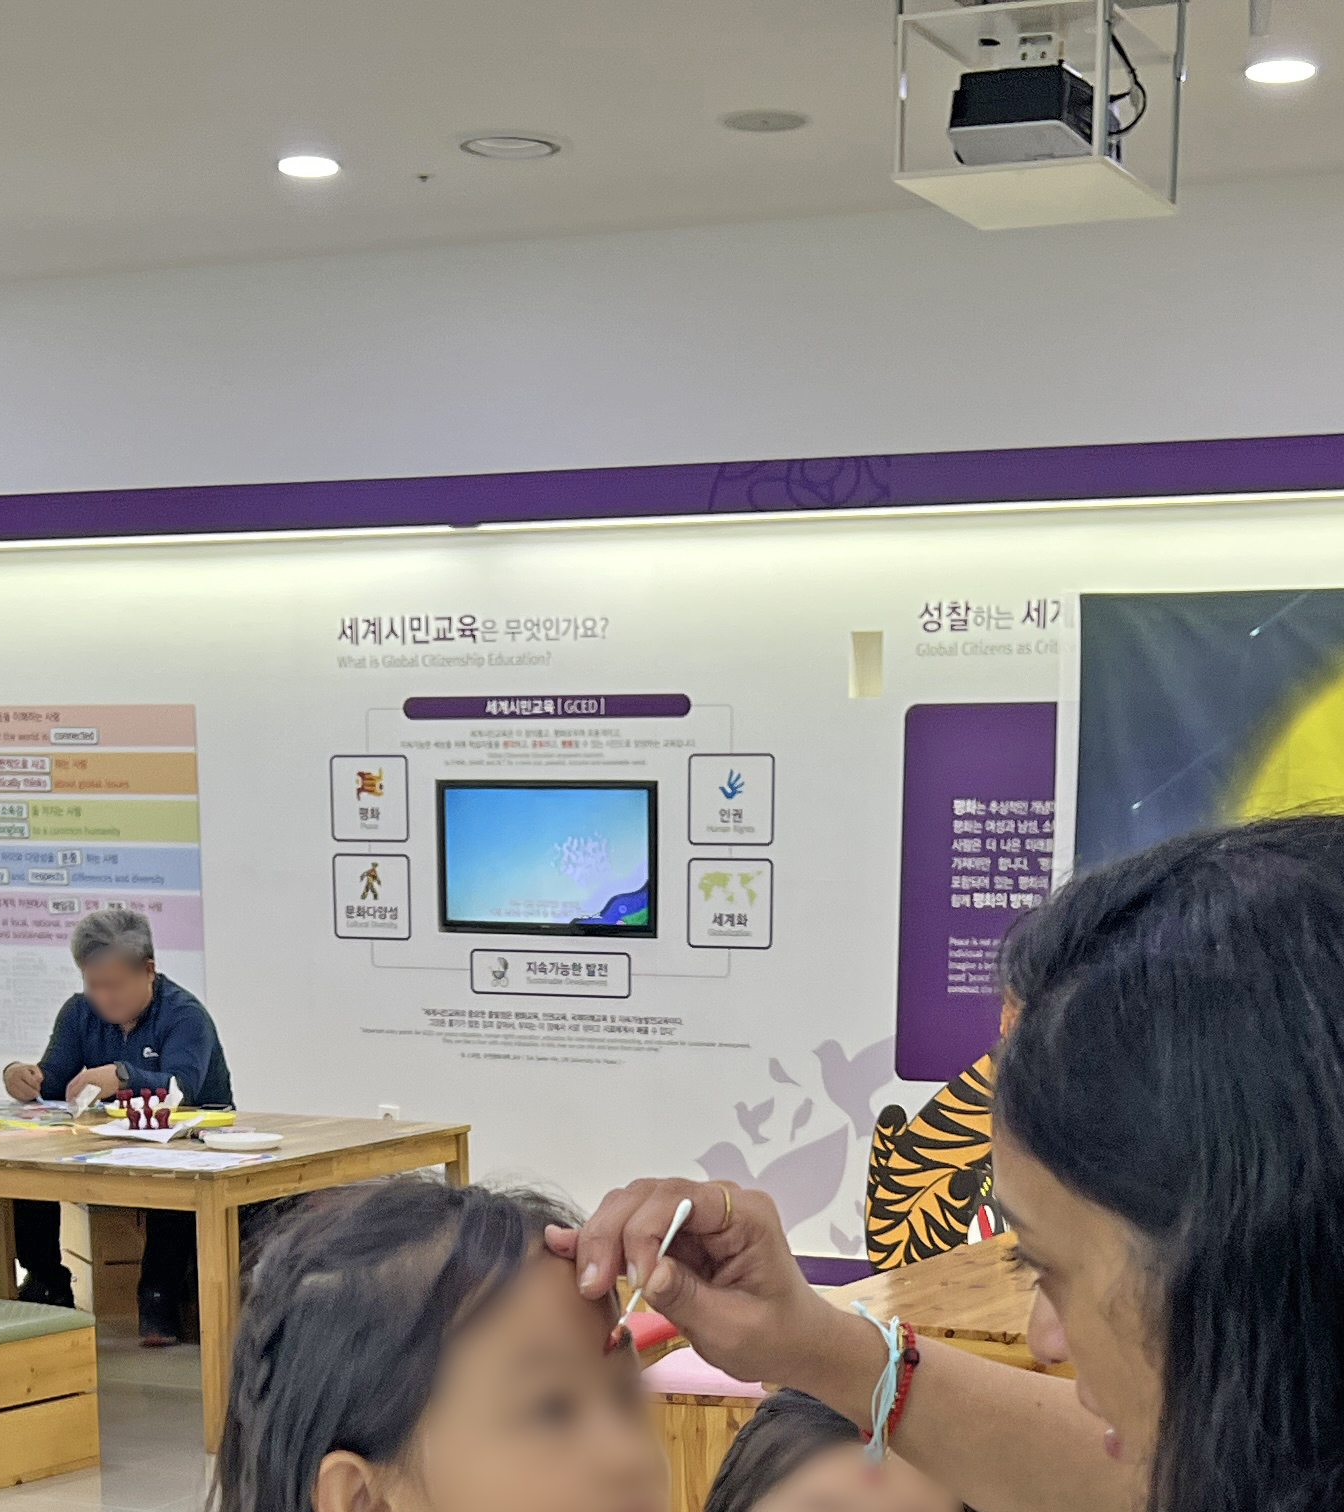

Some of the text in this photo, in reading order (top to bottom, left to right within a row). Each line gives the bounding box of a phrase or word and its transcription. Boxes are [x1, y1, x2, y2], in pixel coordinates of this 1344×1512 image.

[918, 600, 1014, 632] 성찰하는
[337, 614, 609, 645] 세계시민교육은 무엇인가요?
[916, 640, 958, 657] Global
[961, 638, 1014, 657] Citizens
[1016, 641, 1032, 655] as
[382, 654, 419, 669] Global
[421, 653, 485, 669] Citizenship
[485, 699, 555, 715] 세계시민교육
[712, 912, 748, 927] 세계화
[526, 961, 583, 977] 지속가능한
